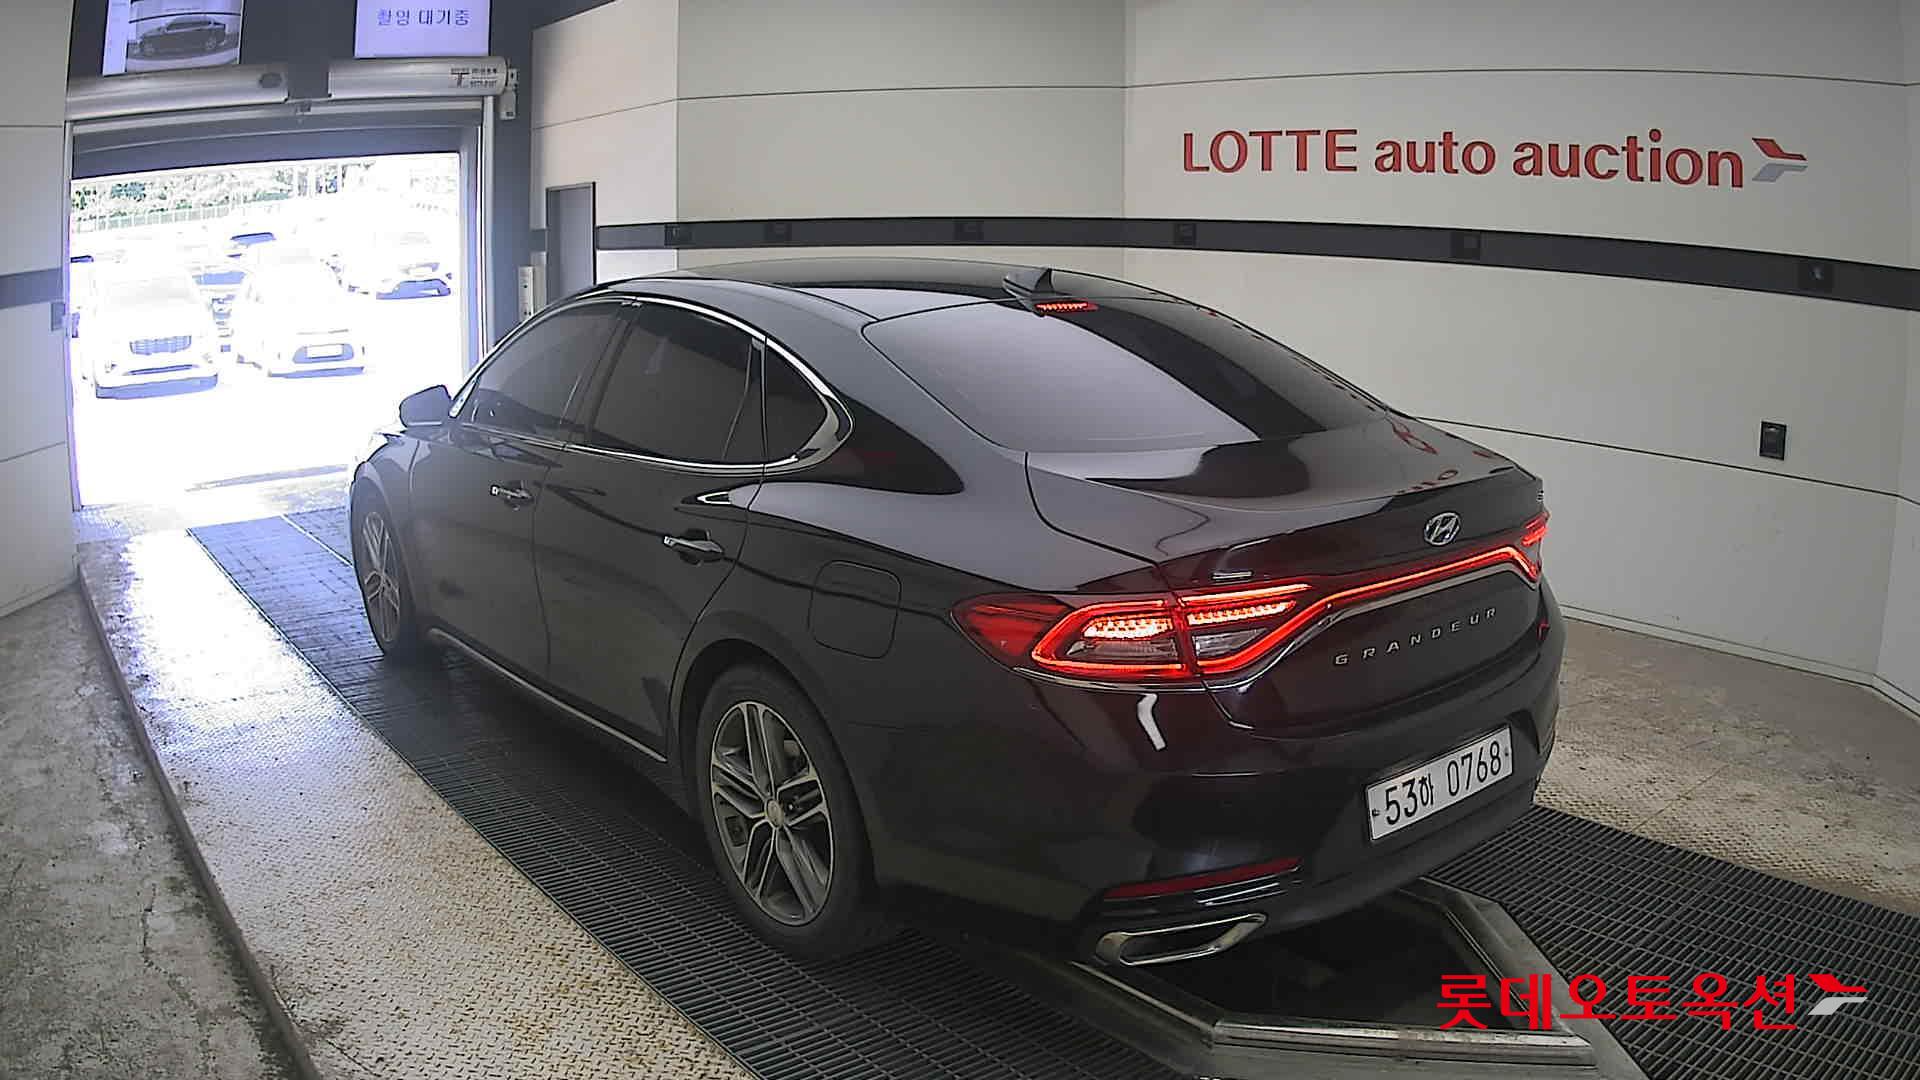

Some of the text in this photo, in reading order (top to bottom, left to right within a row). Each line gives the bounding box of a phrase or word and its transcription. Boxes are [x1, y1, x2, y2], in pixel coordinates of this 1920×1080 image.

[418, 9, 470, 26] 대기중
[1183, 128, 1744, 188] LOTTE auto auction
[1335, 608, 1496, 665] GRANDEUR
[1385, 740, 1501, 825] 53하 0768
